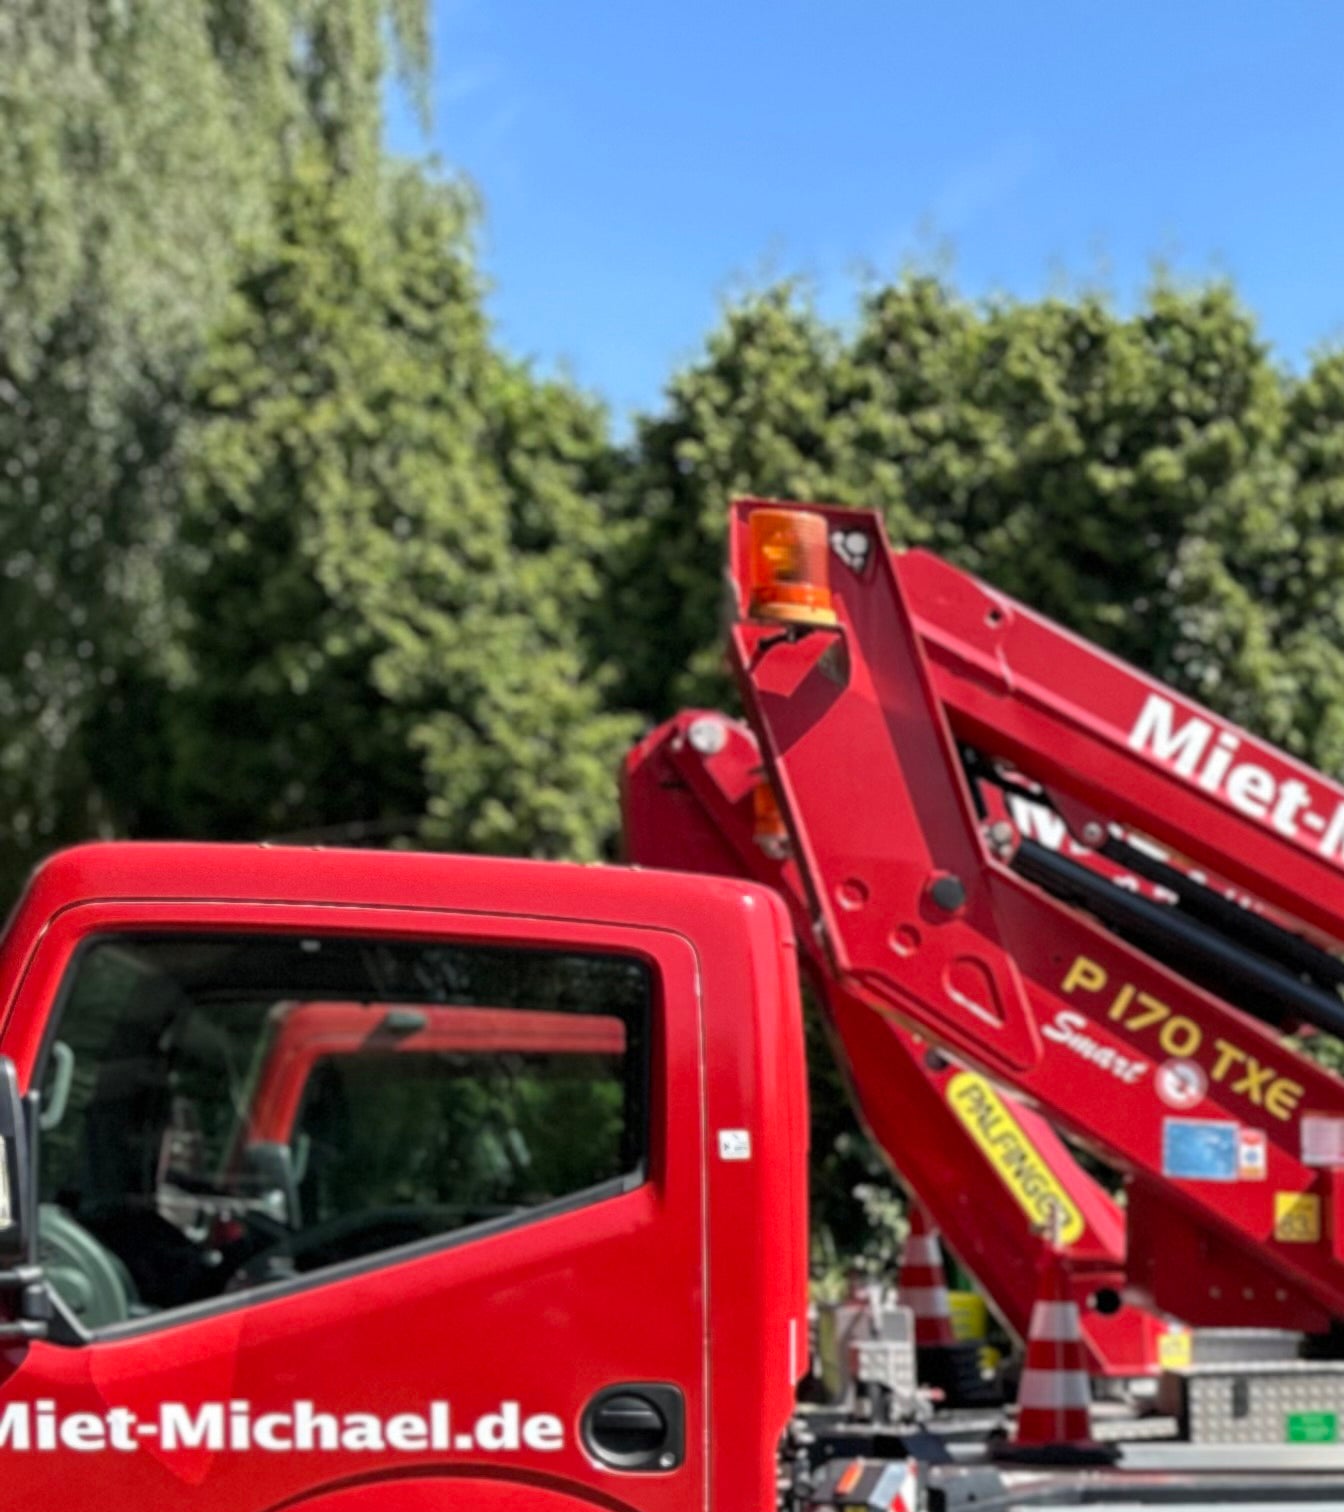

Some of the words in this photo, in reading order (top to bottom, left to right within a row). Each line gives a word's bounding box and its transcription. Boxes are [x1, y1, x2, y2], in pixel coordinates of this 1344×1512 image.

[1041, 1010, 1148, 1084] Smart
[1061, 955, 1108, 993] P
[1108, 984, 1202, 1058] 170
[1210, 1039, 1305, 1122] TXE
